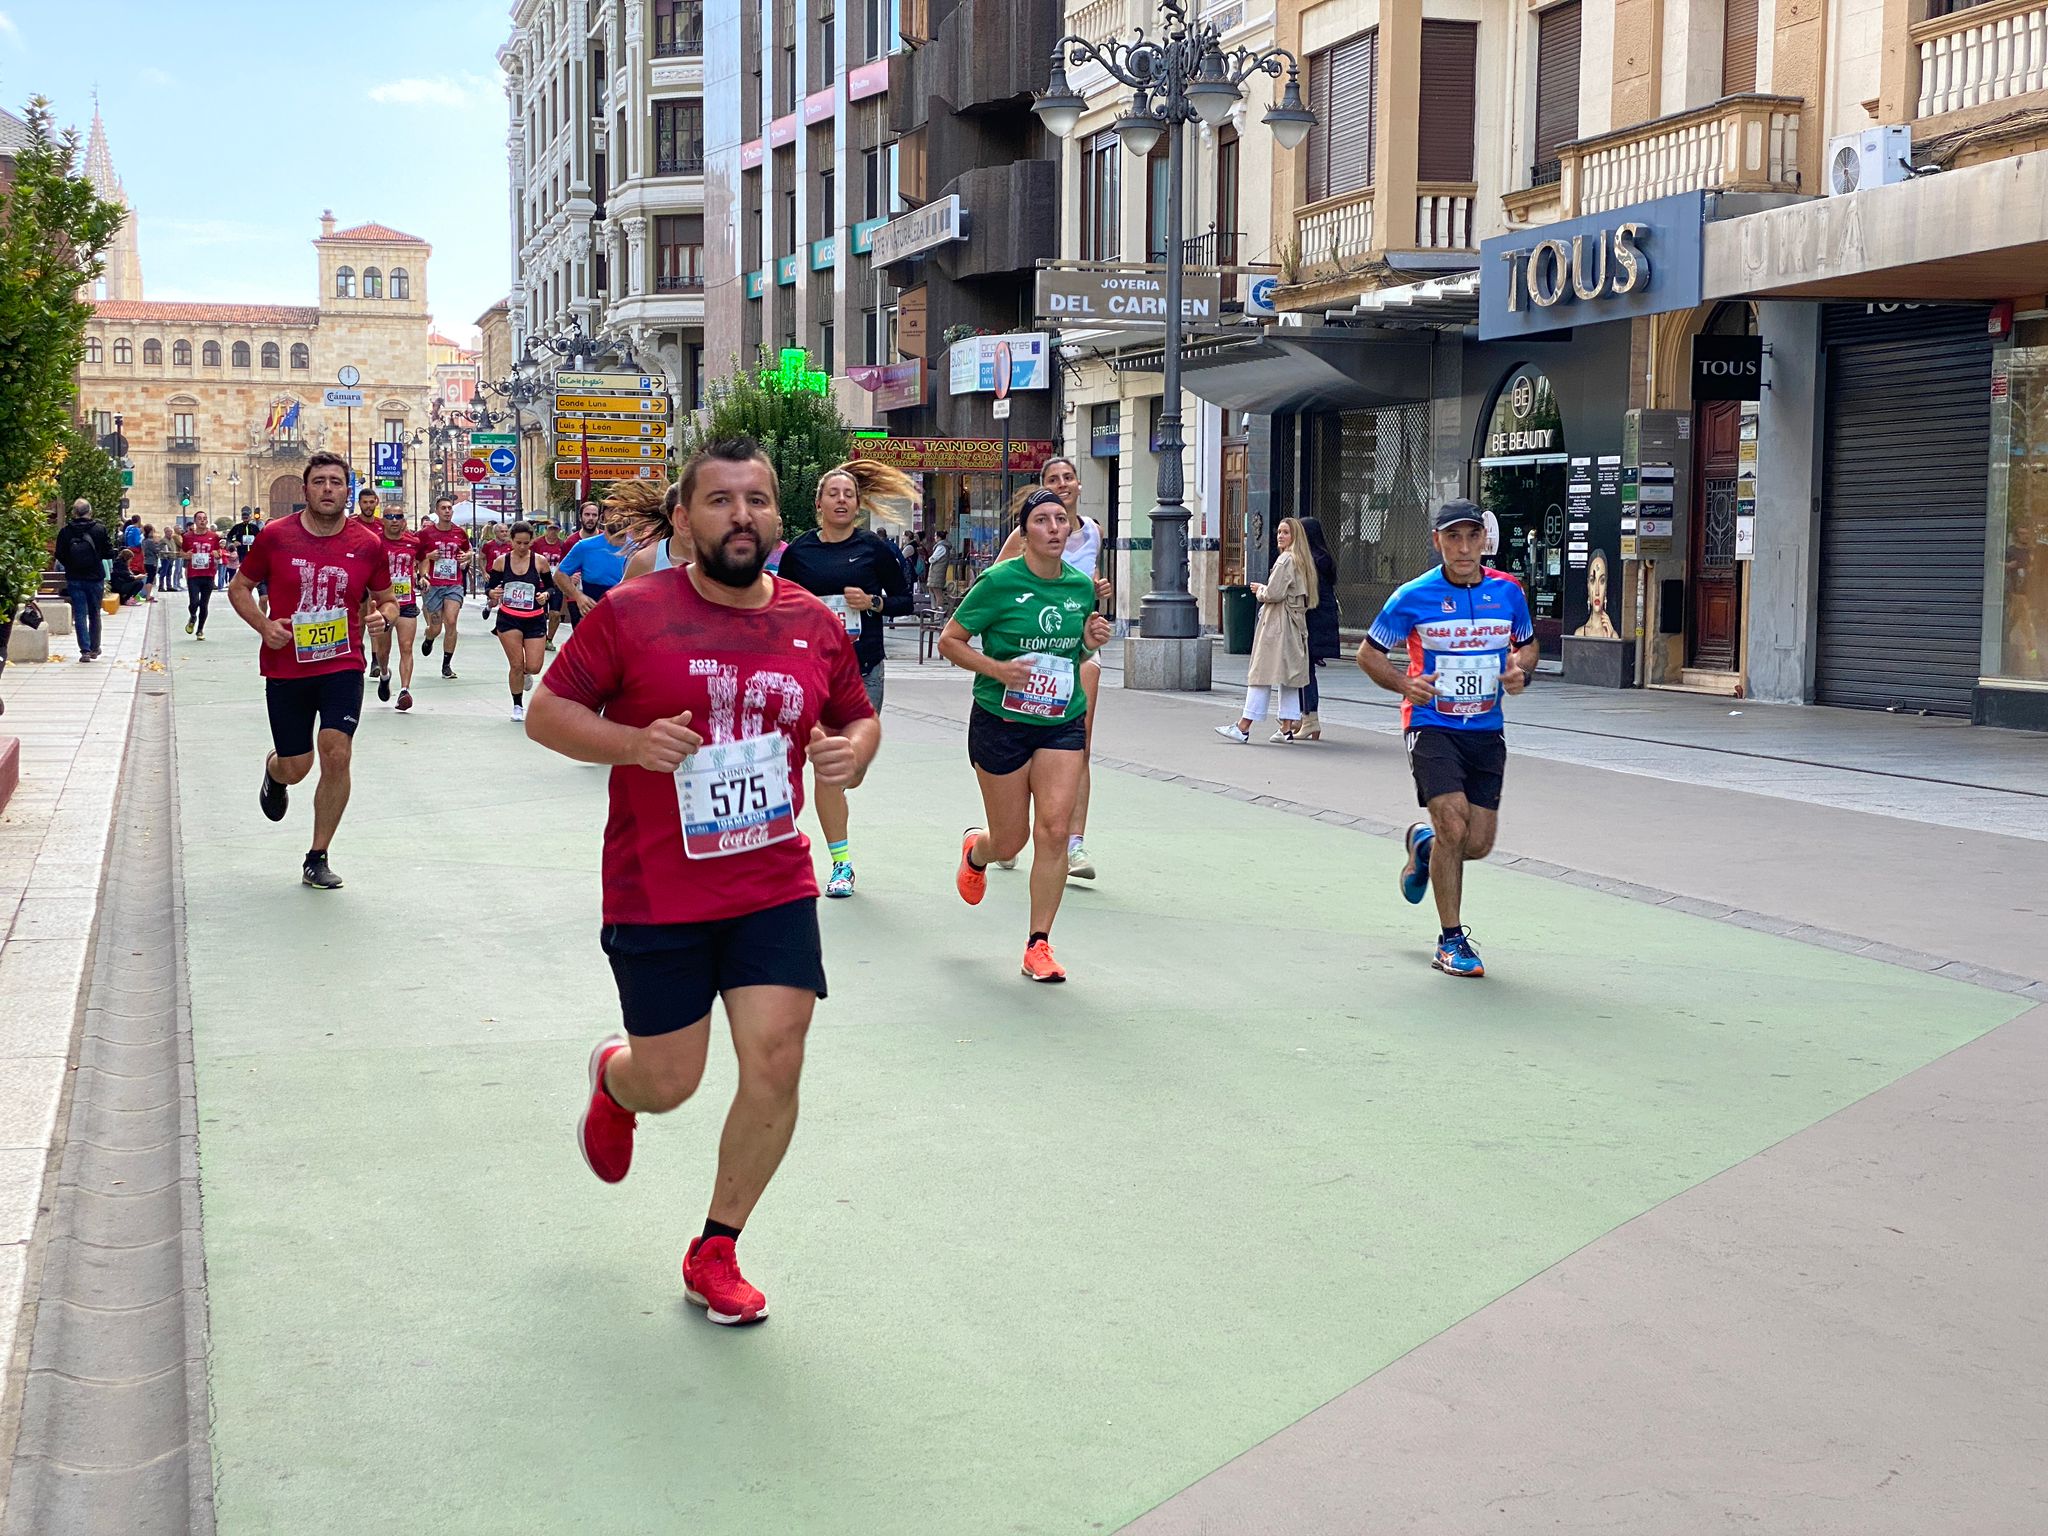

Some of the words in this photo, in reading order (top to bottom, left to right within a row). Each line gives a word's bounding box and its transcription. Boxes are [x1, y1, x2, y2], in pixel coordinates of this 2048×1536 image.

[1500, 222, 1651, 312] TOUS
[1101, 279, 1160, 291] JOYERIA
[1050, 294, 1095, 312] DEL
[1699, 360, 1757, 375] TOUS
[642, 379, 649, 388] P
[327, 392, 361, 402] Cámara
[1514, 388, 1529, 407] BE
[592, 422, 612, 430] León
[1093, 424, 1119, 437] ESTRELLA
[852, 440, 915, 450] ROYAL
[923, 441, 1028, 453] TANDOORI
[1492, 433, 1506, 451] BE
[1509, 429, 1551, 450] BEAUTY
[379, 444, 392, 466] P
[860, 452, 897, 460] INDIAN
[901, 452, 971, 460] RESTAURANT
[1547, 516, 1561, 534] BE
[309, 625, 336, 645] 257
[1426, 627, 1451, 637] CASA
[1454, 627, 1468, 637] DE
[1020, 636, 1046, 650] LEÓN
[1449, 637, 1488, 649] LEÓN
[689, 659, 717, 668] 2022
[1023, 673, 1057, 697] 634
[1455, 675, 1482, 695] 381
[709, 774, 767, 817] 575
